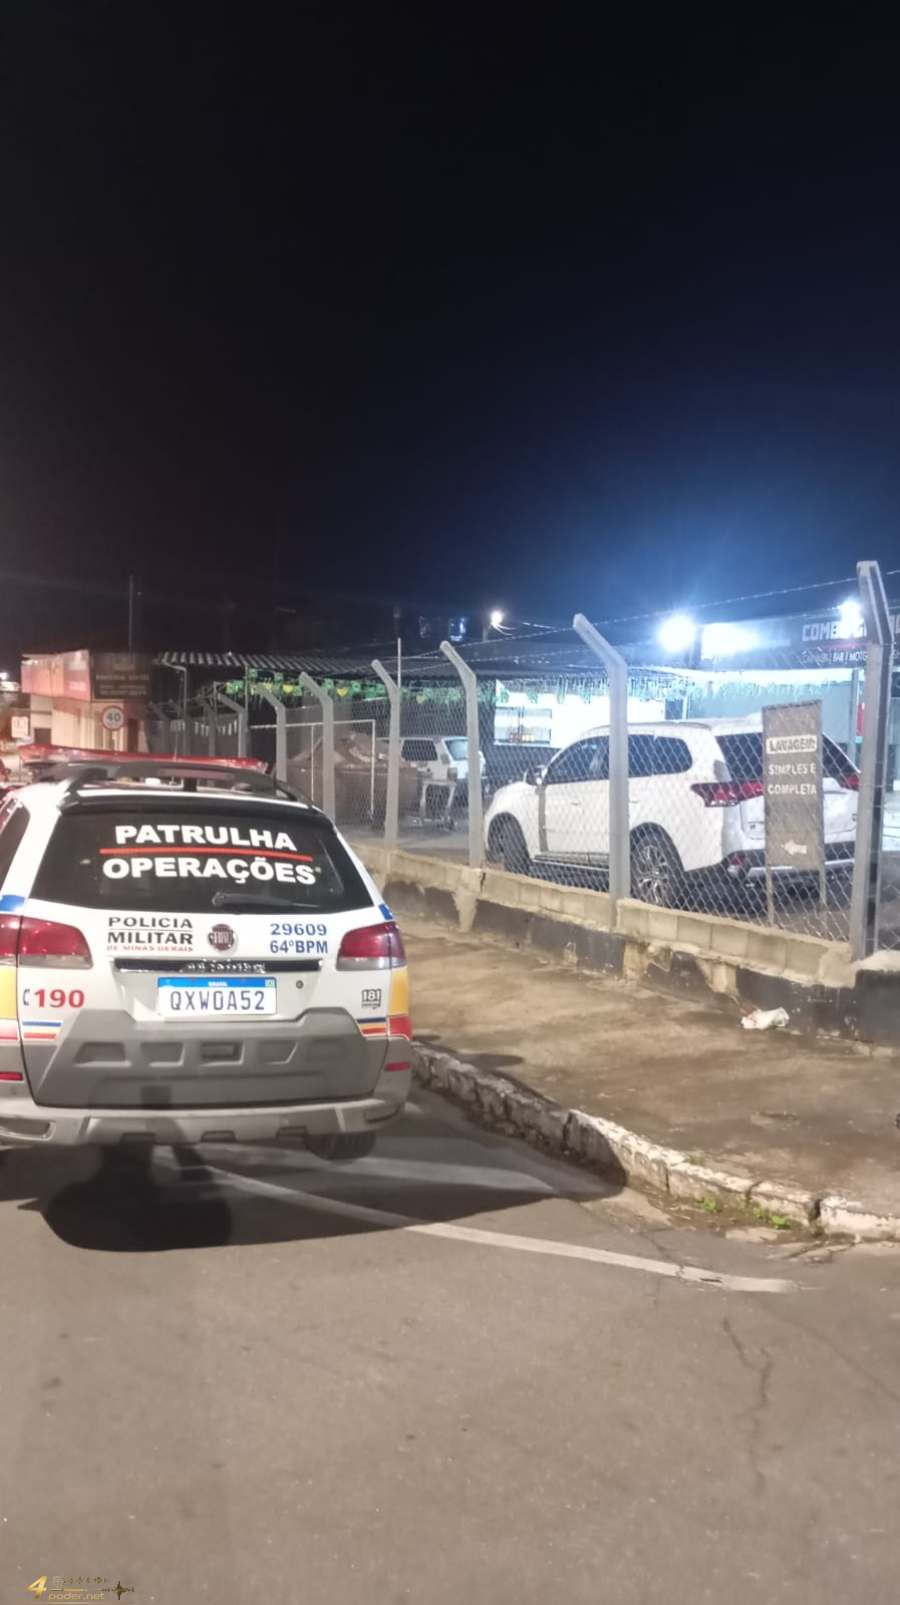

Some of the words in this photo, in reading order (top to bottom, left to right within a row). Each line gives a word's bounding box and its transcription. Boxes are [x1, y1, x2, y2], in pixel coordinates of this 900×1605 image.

[105, 712, 122, 722] 40
[768, 764, 808, 775] SIMPLES
[810, 763, 816, 773] E
[768, 784, 817, 795] COMPLETA
[115, 825, 298, 851] PATRULHA
[103, 856, 316, 885] OPERAÇÕES
[108, 917, 193, 929] POLICIA
[270, 923, 327, 936] 29609
[107, 932, 193, 945] MILITAR
[34, 989, 85, 1008] 190
[363, 990, 380, 1001] 181
